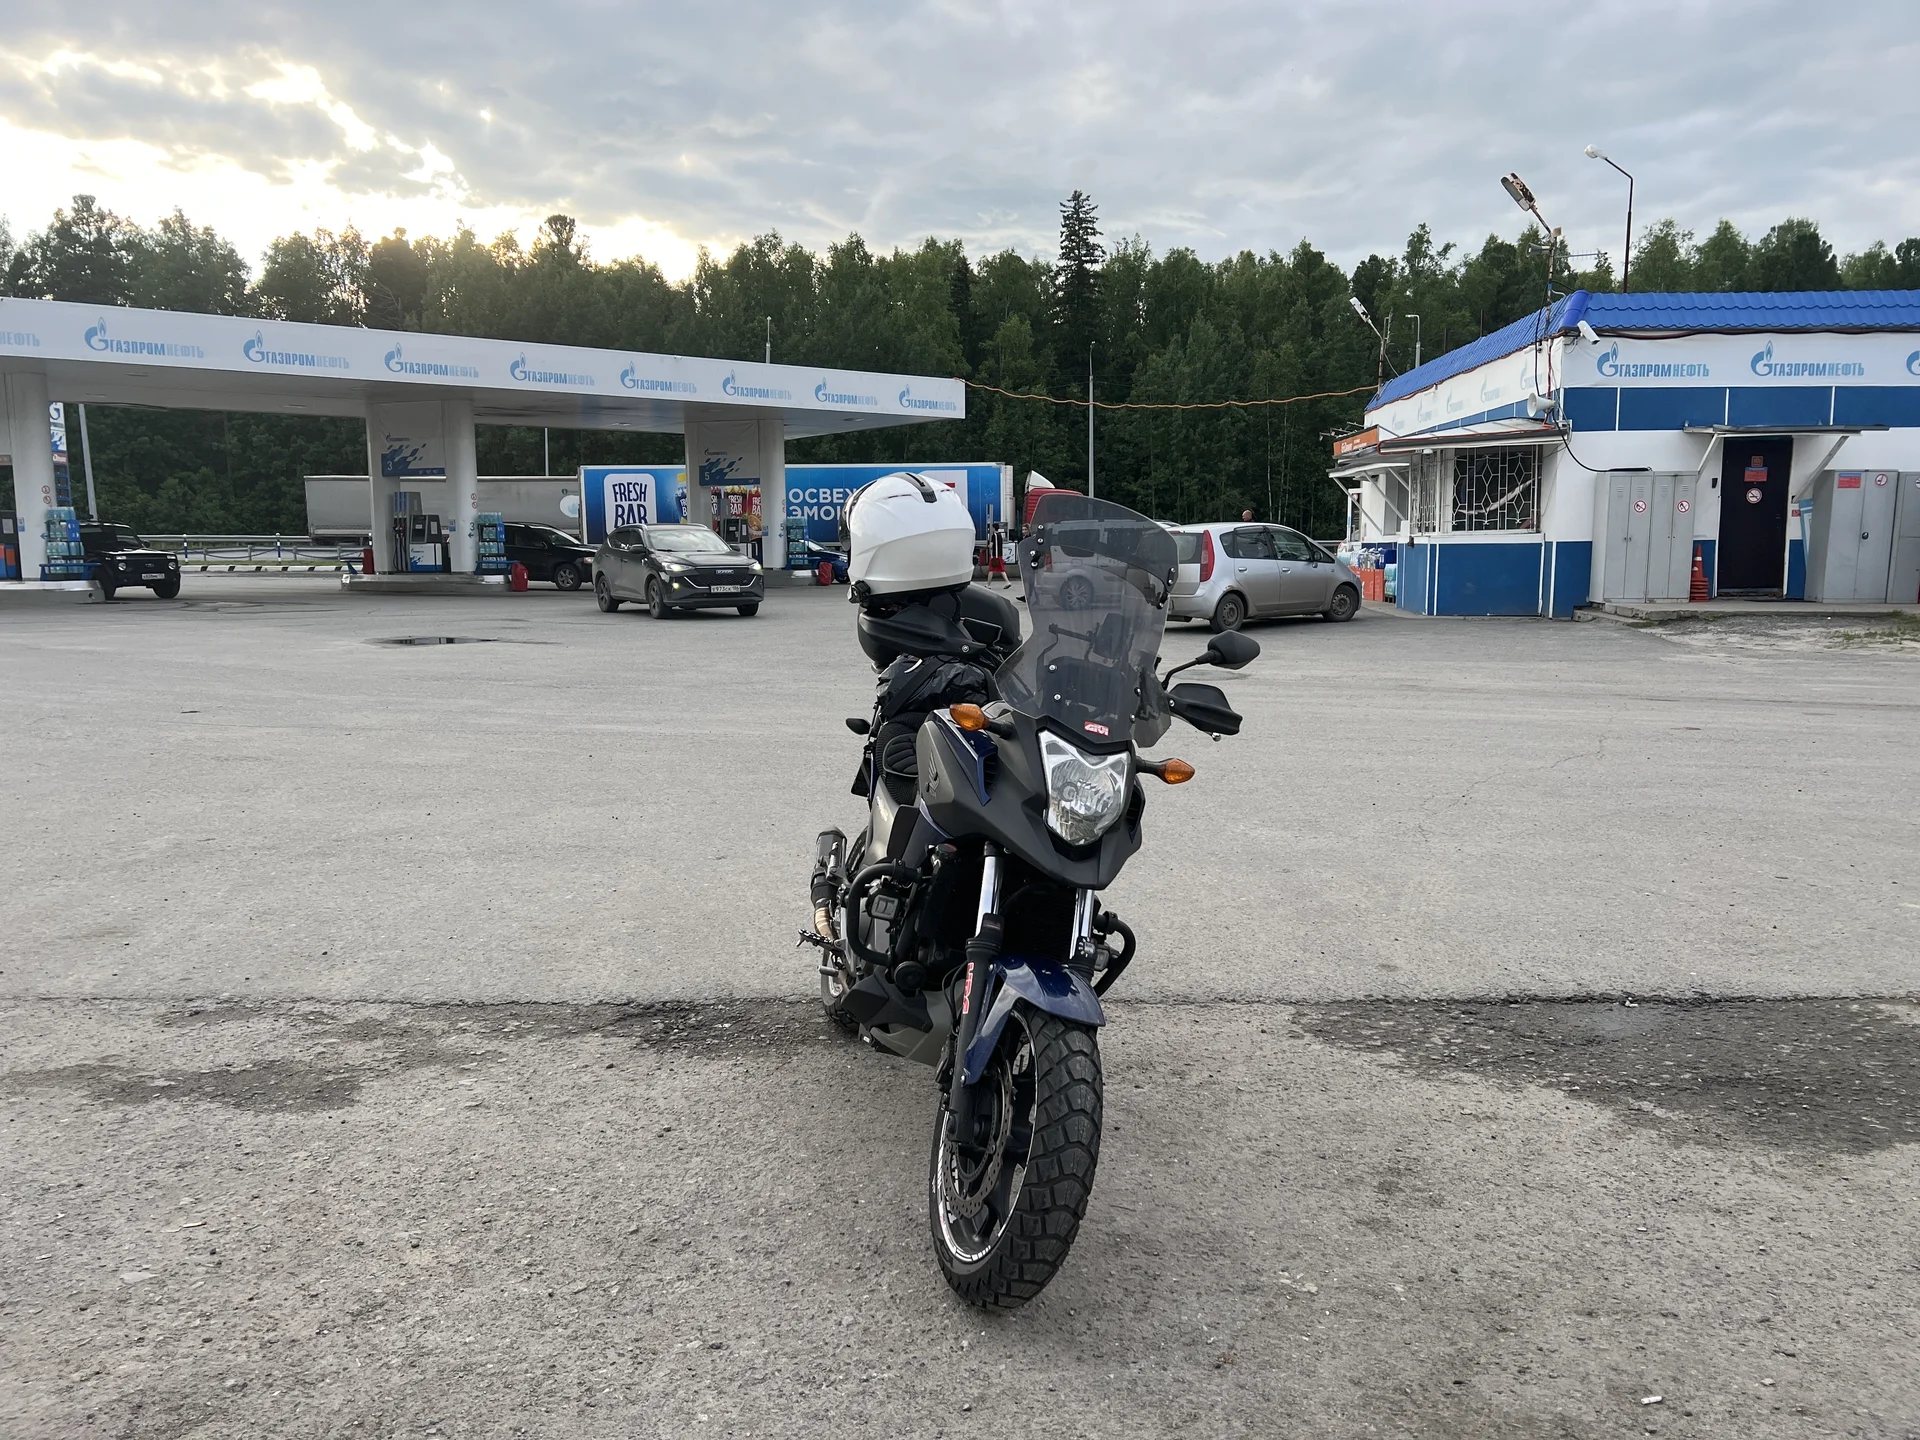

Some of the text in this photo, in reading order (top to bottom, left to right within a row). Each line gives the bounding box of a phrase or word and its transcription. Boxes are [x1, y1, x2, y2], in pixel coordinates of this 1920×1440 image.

[109, 339, 204, 359] ГАЗПРОМНЕФТЬ
[265, 351, 349, 369] ГАЗПРОМНЕФТЬ
[404, 361, 479, 378] ГАЗПРОМНЕФТЬ
[1619, 363, 1710, 378] ГАЗПРОМНЕФТЬ
[1772, 362, 1865, 377] ГАЗПРОМНЕФТЬ
[527, 371, 595, 387] ГАЗПРОМНЕФТЬ
[636, 379, 697, 394] ГАЗПРОМНЕФТЬ
[736, 387, 792, 401] ГАЗПРОМНЕФТЬ
[827, 393, 878, 406] ГАЗПРОМНЕФТЬ
[910, 399, 957, 412] ГАЗПРОМНЕФТЬ
[386, 461, 393, 470] 3
[704, 471, 710, 480] 5
[612, 482, 648, 502] FRESH
[614, 503, 648, 528] BAR
[789, 505, 842, 520] ЭМО
[469, 522, 475, 531] 3
